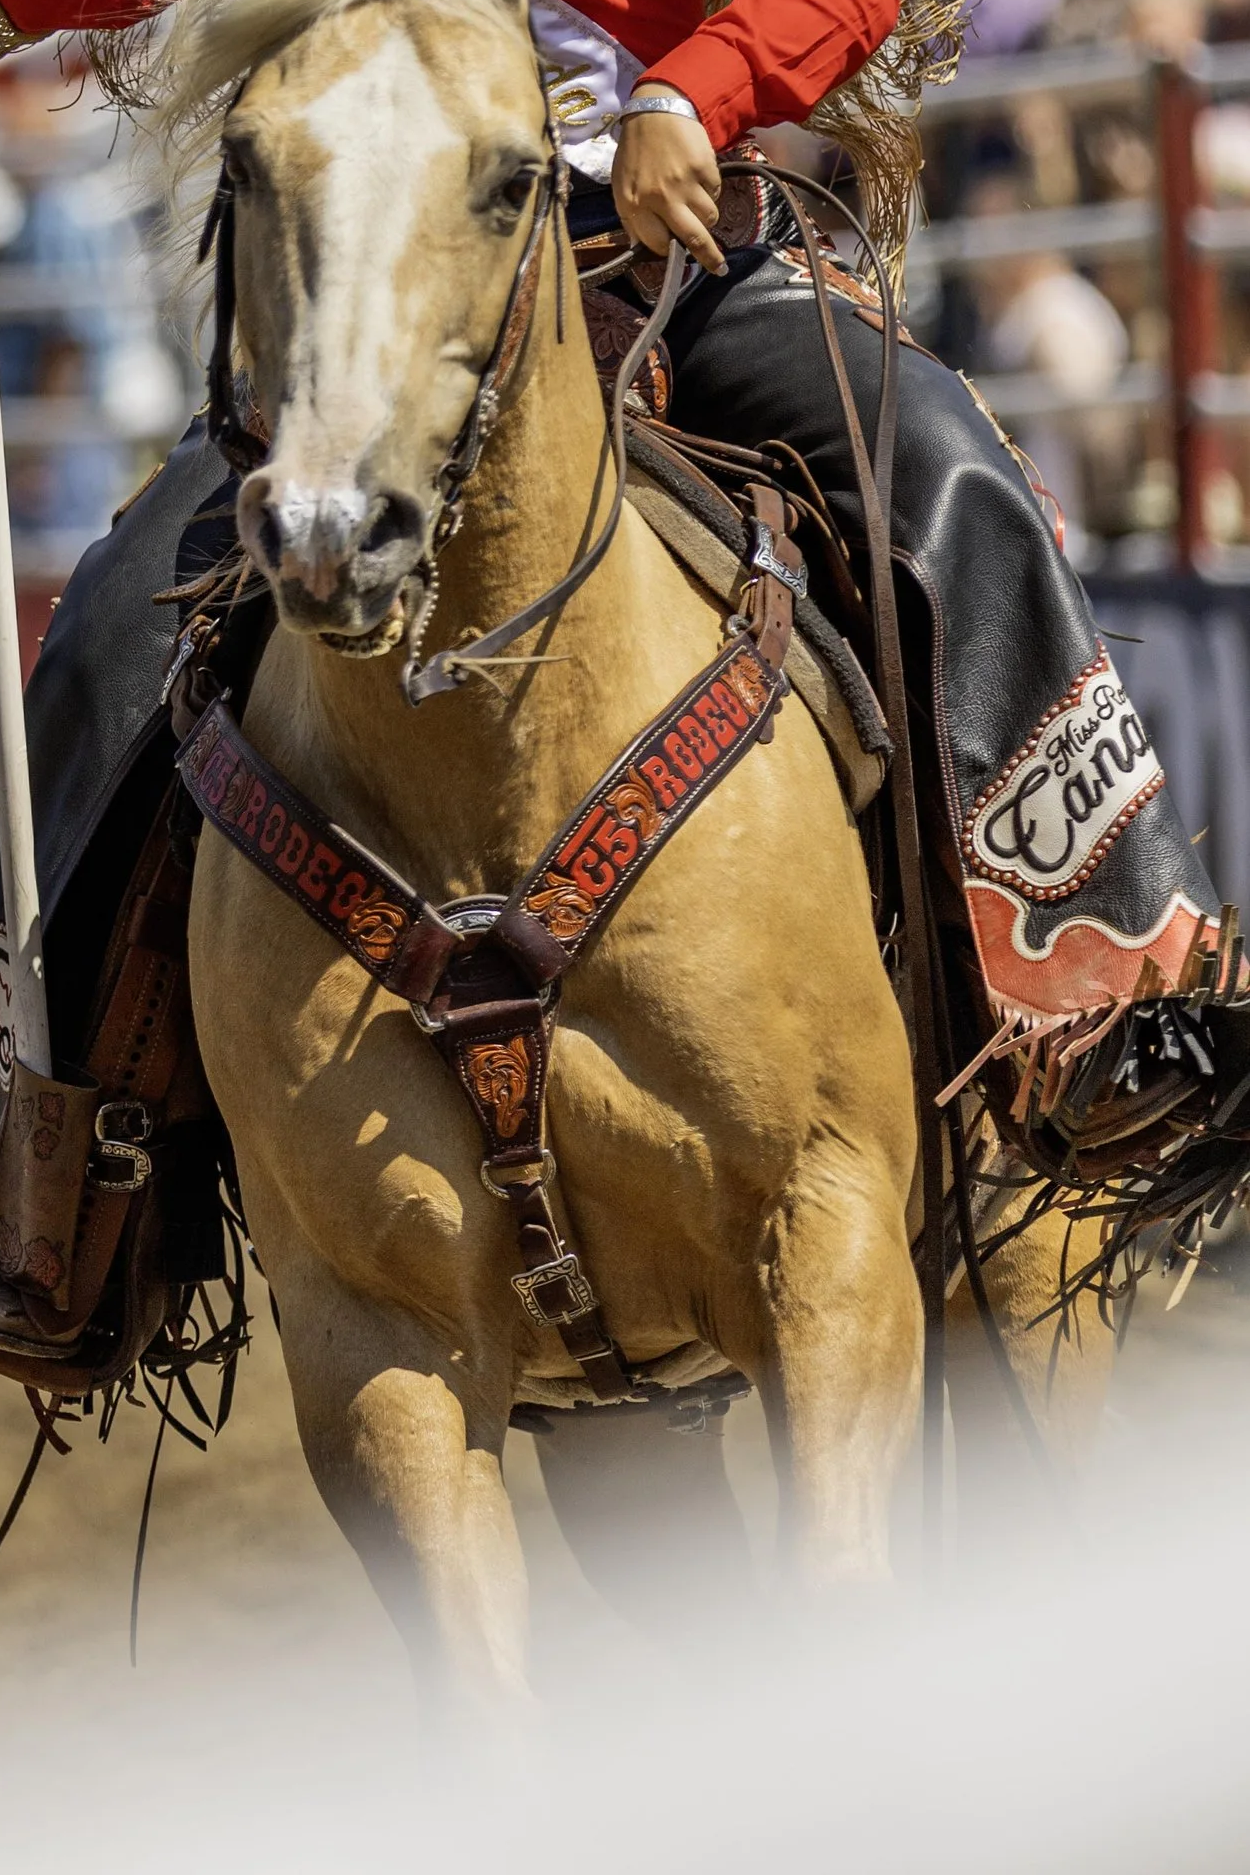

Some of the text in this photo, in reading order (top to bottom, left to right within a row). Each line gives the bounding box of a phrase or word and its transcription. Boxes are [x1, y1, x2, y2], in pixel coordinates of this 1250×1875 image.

[570, 681, 750, 896] C5 RODEO
[1046, 718, 1100, 776] Miss
[236, 780, 367, 919] RODEO
